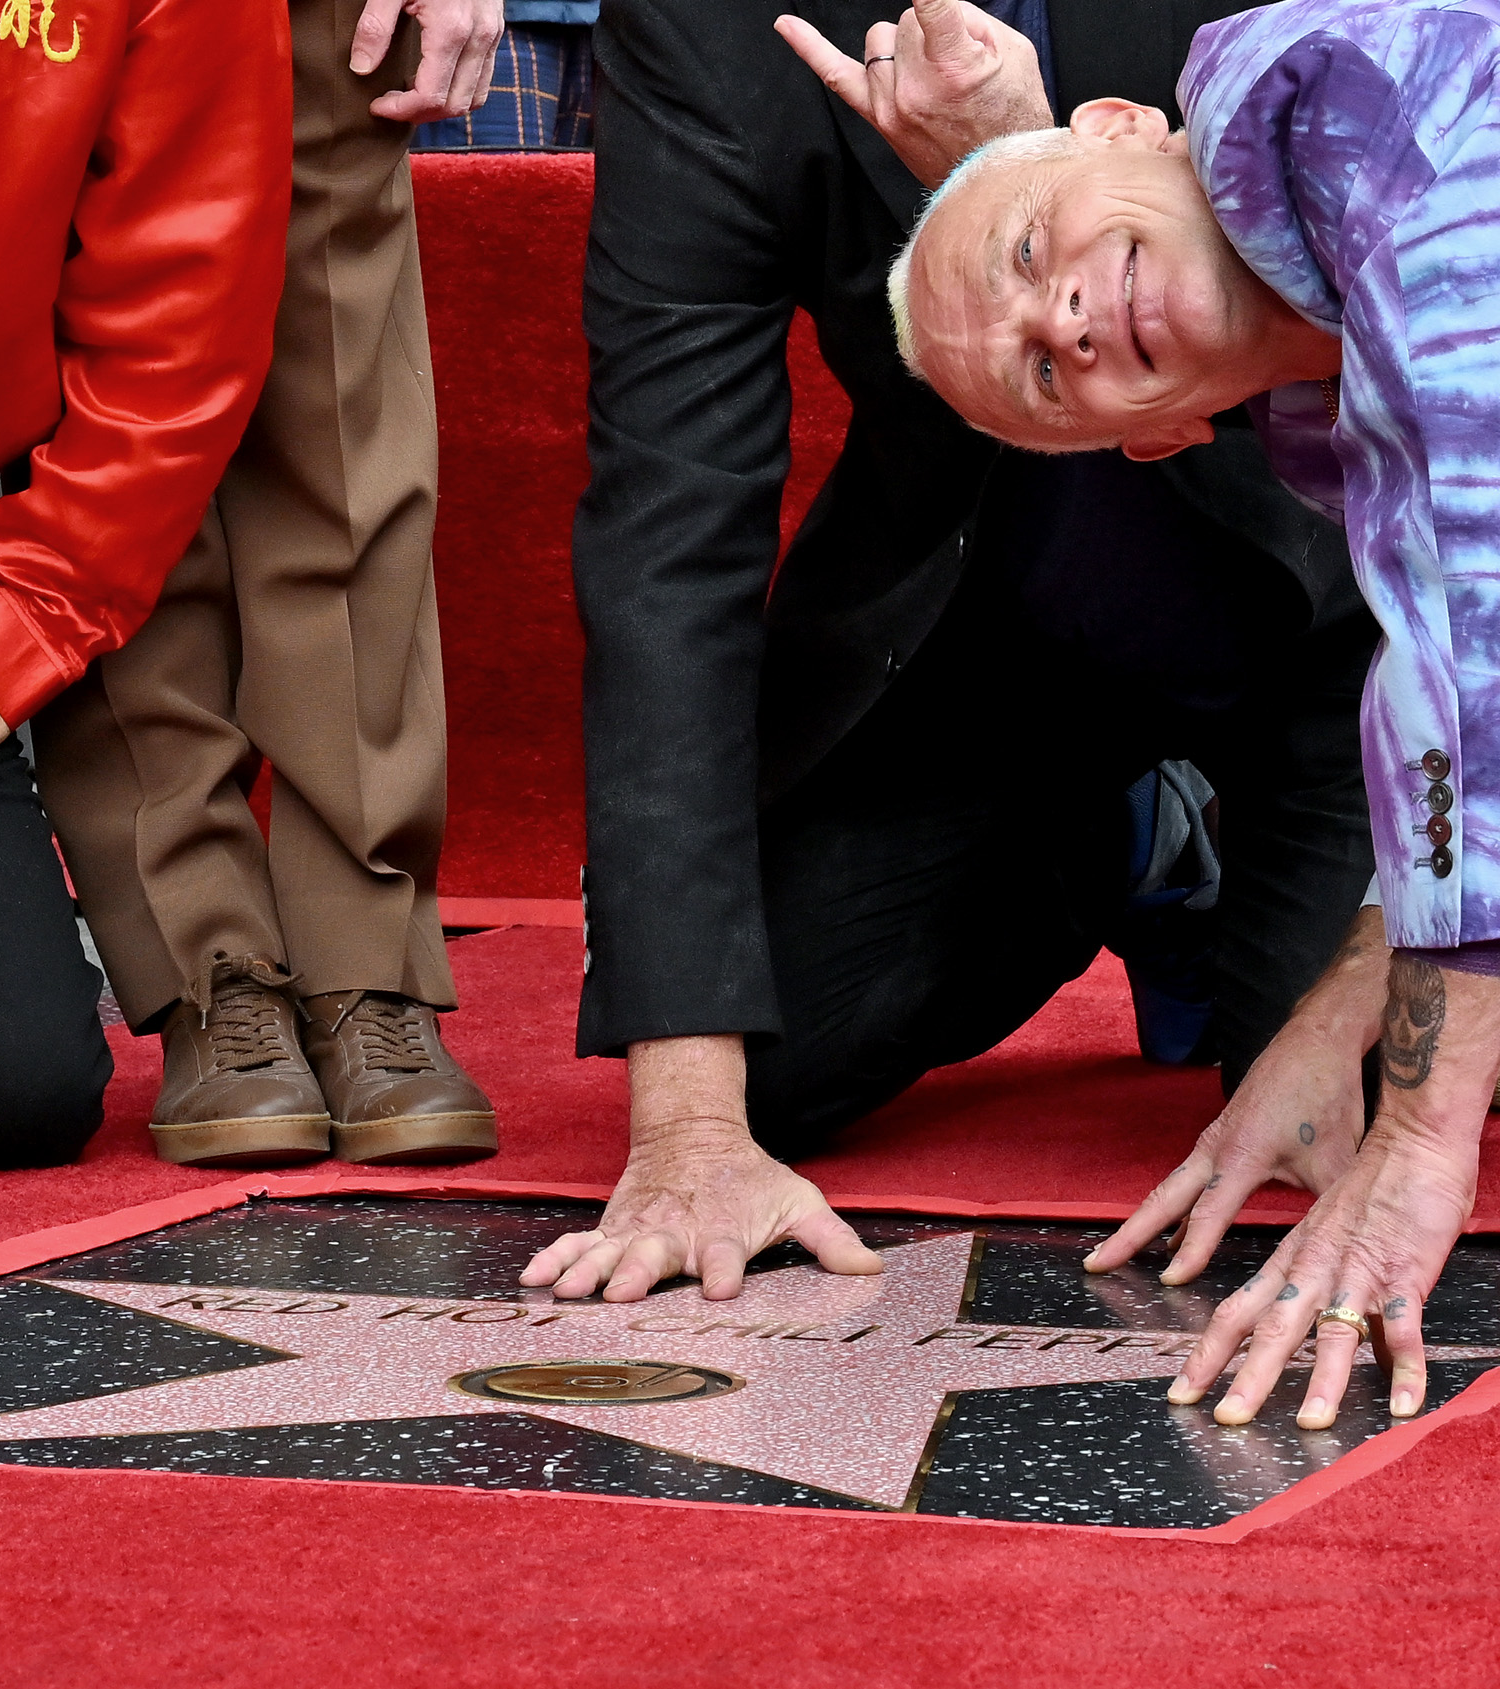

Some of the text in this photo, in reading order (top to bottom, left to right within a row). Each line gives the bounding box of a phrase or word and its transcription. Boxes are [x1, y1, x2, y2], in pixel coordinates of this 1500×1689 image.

[158, 1293, 349, 1314] RED
[378, 1302, 596, 1327] HOT
[628, 1315, 883, 1343] CHILI
